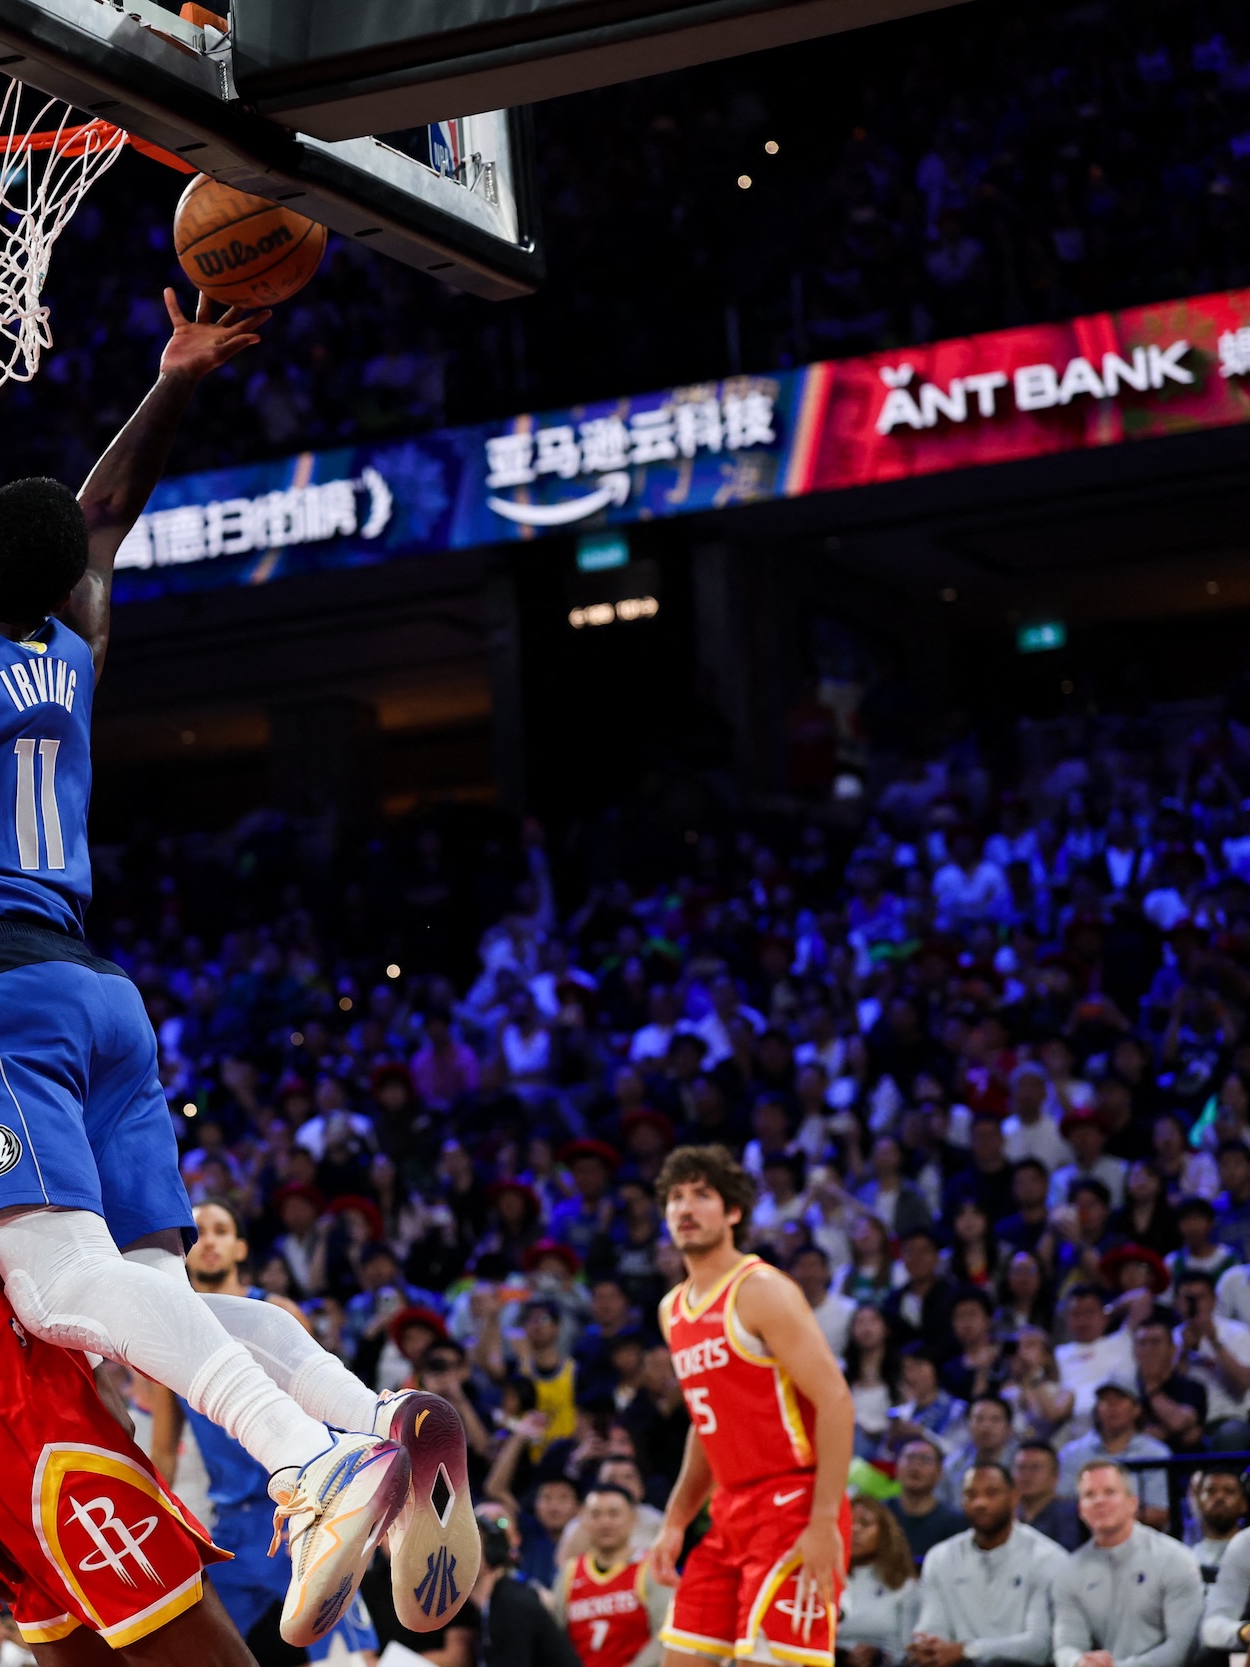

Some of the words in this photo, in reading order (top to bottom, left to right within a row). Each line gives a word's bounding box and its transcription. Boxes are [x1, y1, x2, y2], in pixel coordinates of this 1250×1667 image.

[193, 225, 293, 277] Wilson
[1013, 339, 1195, 412] BANK
[0, 657, 77, 713] IRVING
[14, 738, 65, 870] 11
